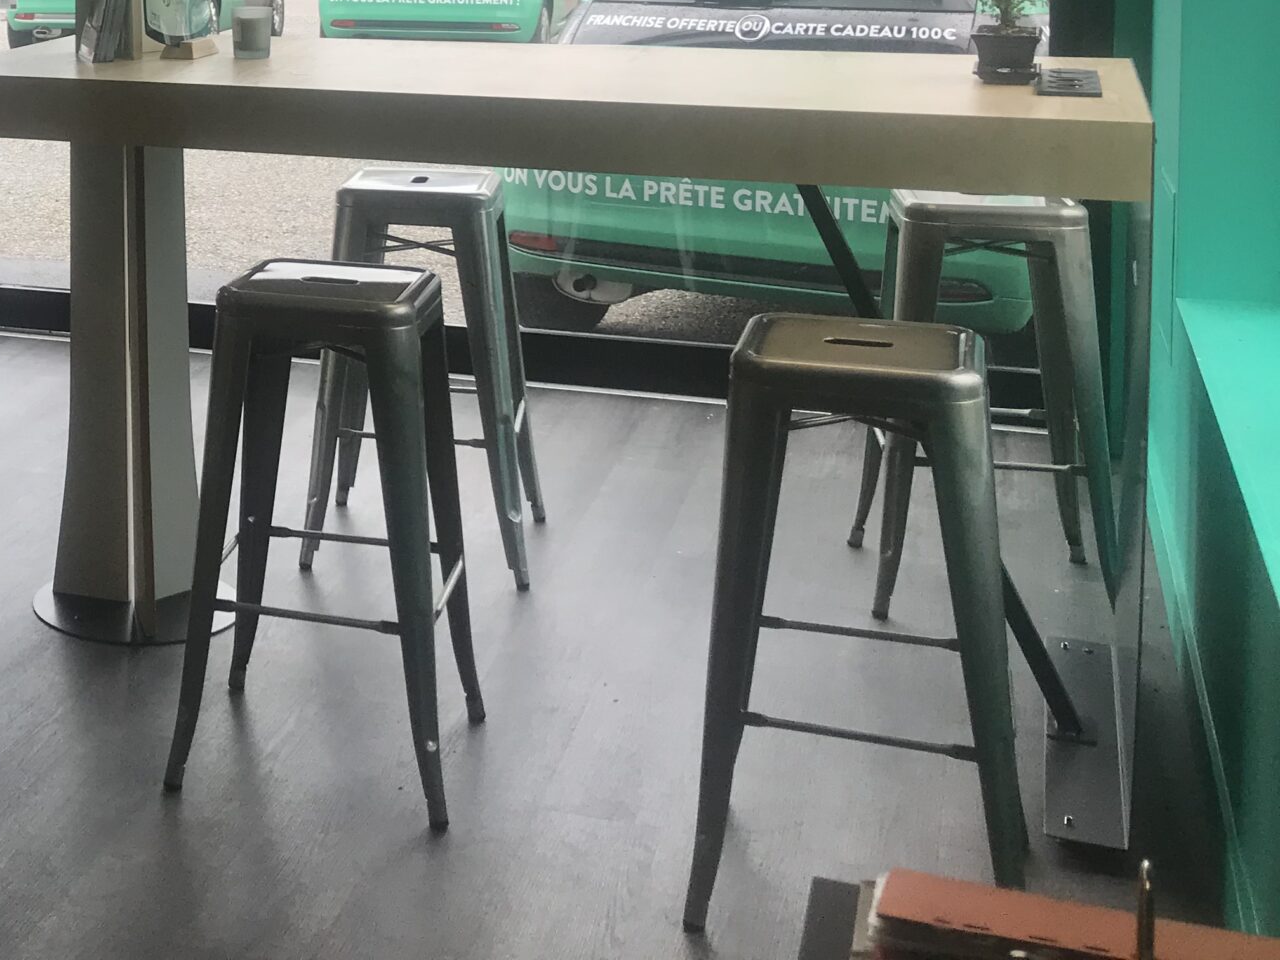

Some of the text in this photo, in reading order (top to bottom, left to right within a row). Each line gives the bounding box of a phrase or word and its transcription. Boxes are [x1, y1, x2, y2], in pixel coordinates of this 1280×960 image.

[586, 14, 958, 41] FRANCHISE OFFERTE OU CARTE CADEAU 100€
[504, 167, 890, 224] ON VOUS LA PRÊTE GRATITE
